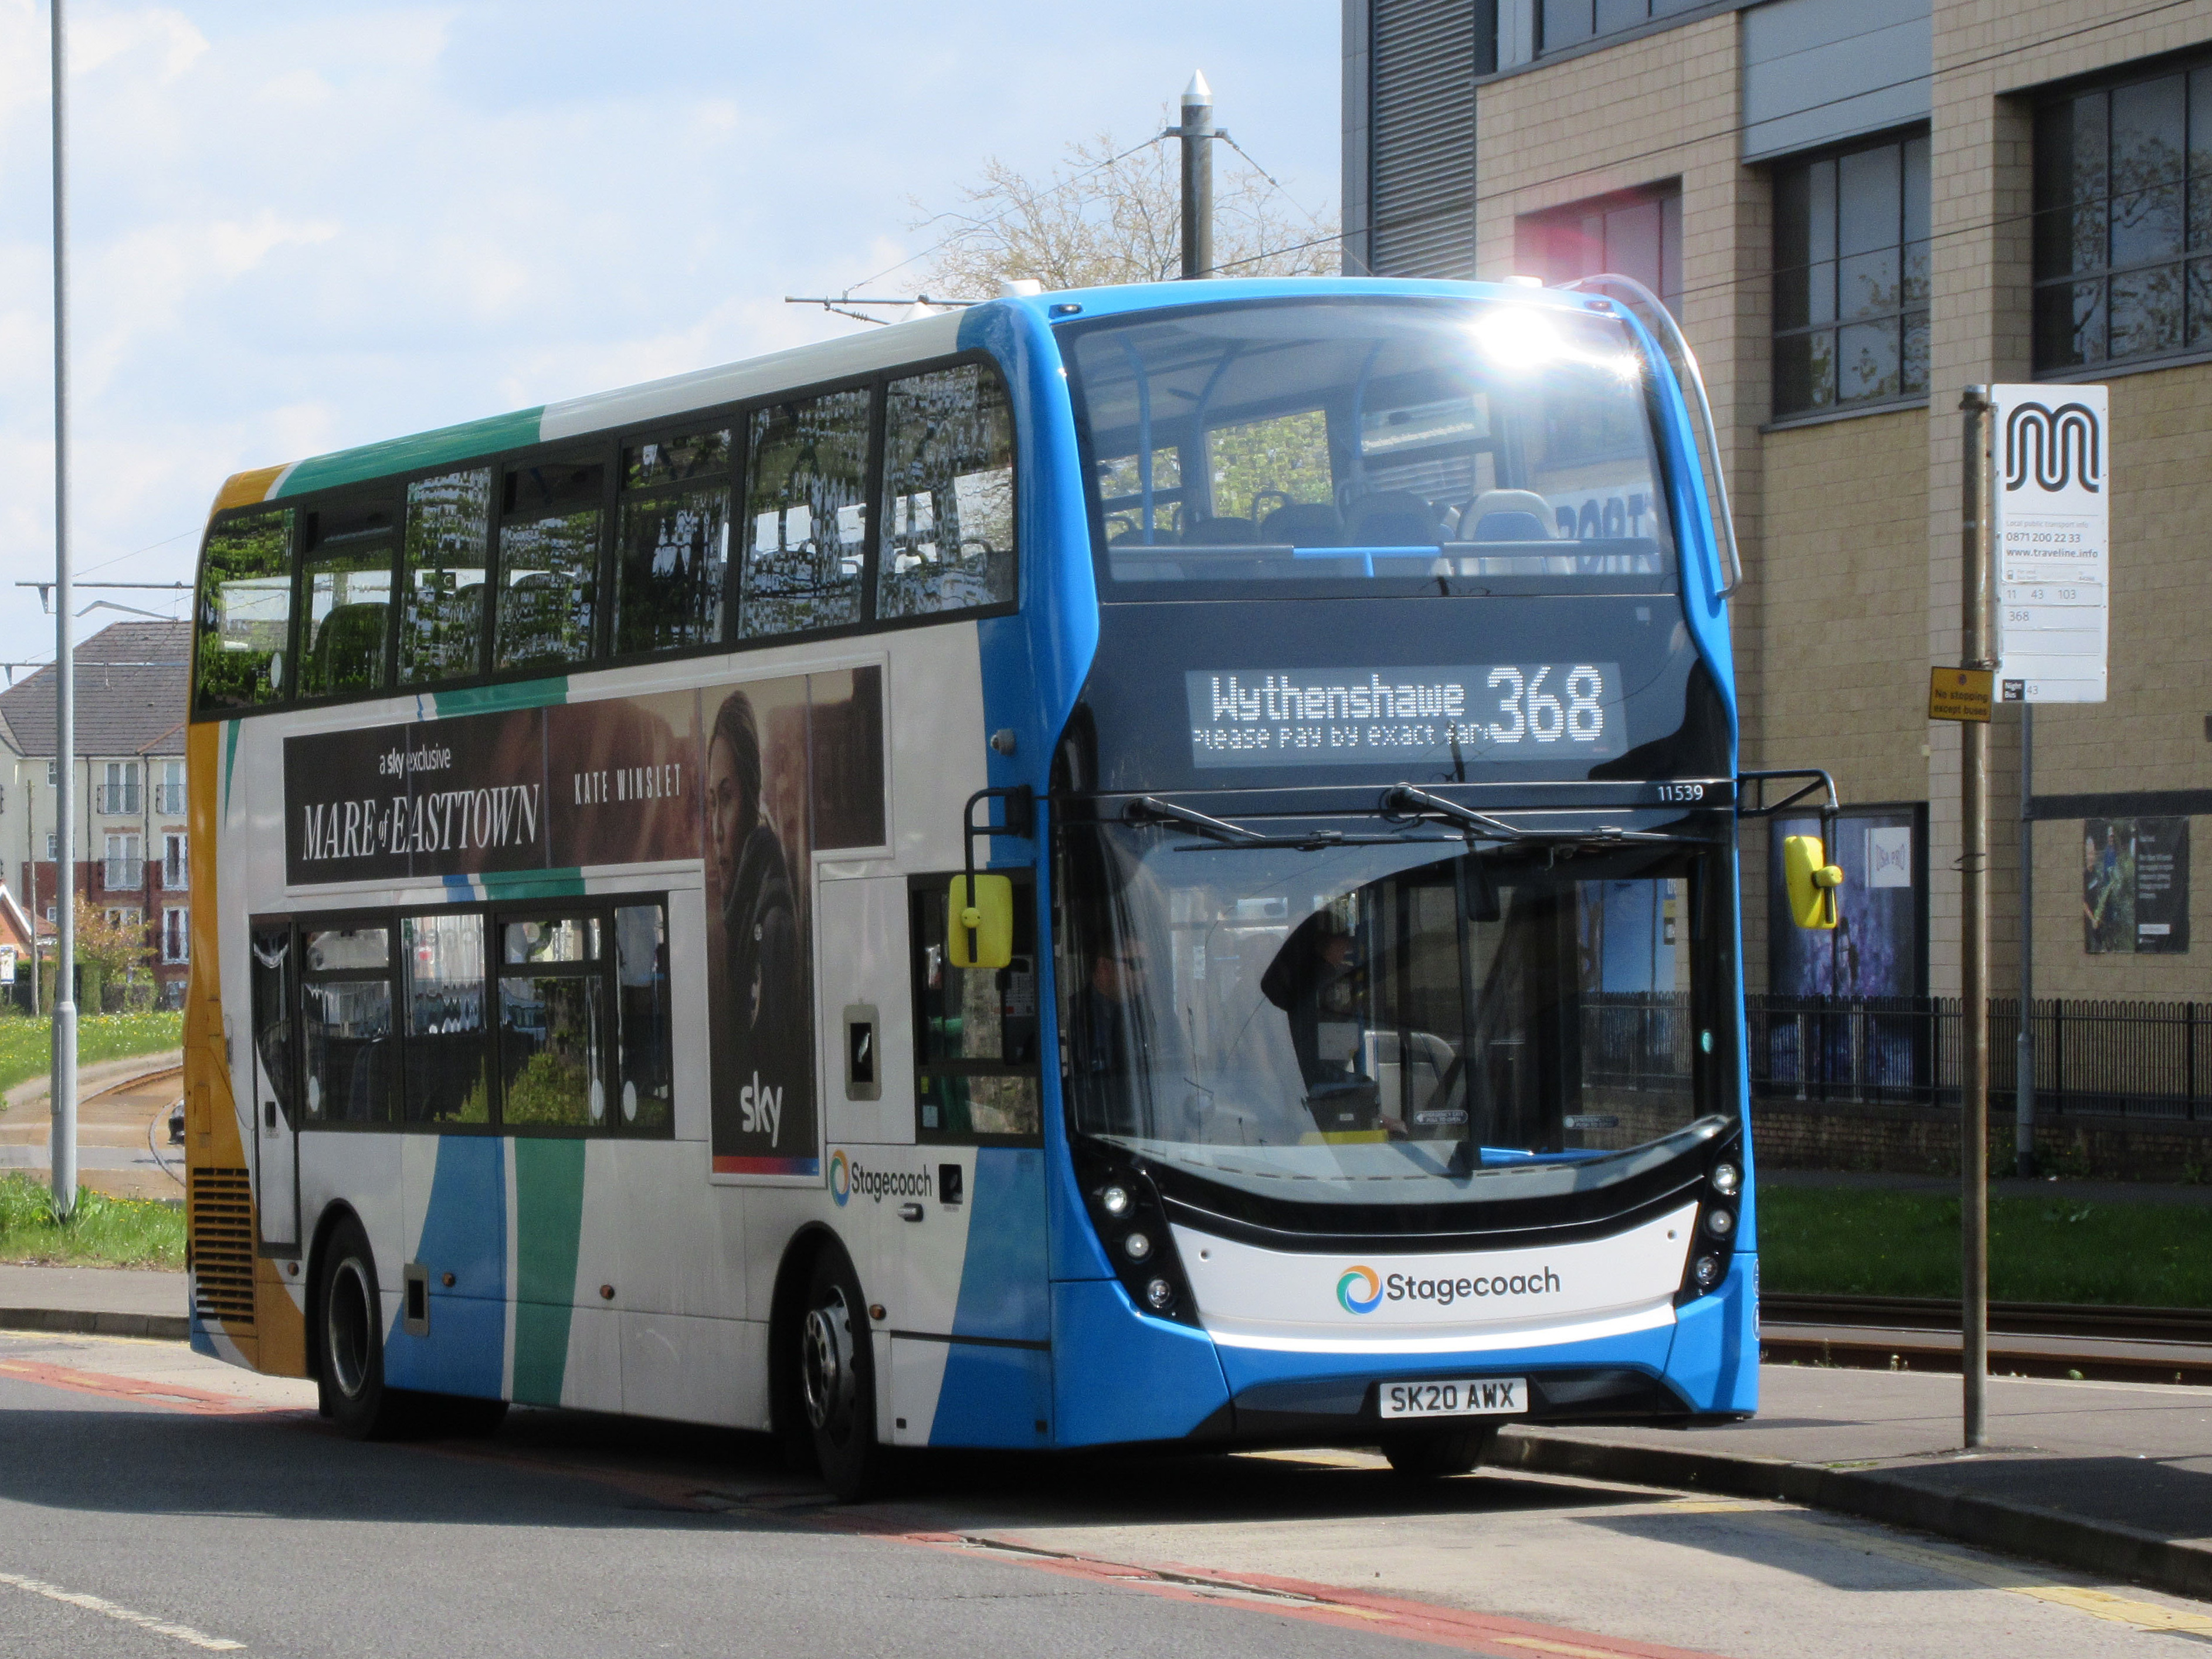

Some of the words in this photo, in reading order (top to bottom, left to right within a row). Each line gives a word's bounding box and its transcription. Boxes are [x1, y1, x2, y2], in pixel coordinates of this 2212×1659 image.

[2006, 532, 2030, 541] 0871
[2031, 533, 2052, 542] 200
[2054, 534, 2066, 542] 22
[2068, 534, 2081, 543] 33
[2006, 548, 2099, 558] www.traveline.info
[2007, 590, 2017, 599] 11
[2031, 589, 2044, 599] 43
[2058, 590, 2077, 599] 103
[2009, 611, 2029, 622] 368
[1211, 673, 1466, 722] Wythenshawe
[1487, 665, 1604, 743] 368
[1935, 690, 1947, 699] No
[1950, 691, 1990, 703] stopping
[2026, 686, 2039, 694] 43
[1933, 705, 1962, 715] except
[1963, 705, 1987, 715] buses
[380, 755, 386, 775] a
[387, 750, 405, 779] sky
[406, 745, 451, 771] exclusive
[574, 770, 608, 805] KATE
[617, 764, 681, 801] WINSLET
[1658, 785, 1704, 801] 11539
[302, 799, 376, 861] MARE
[391, 783, 540, 854] EASTTOWN
[740, 1071, 782, 1148] sky
[851, 1162, 932, 1203] Stagecoach
[1387, 1266, 1560, 1305] Stagecoach
[1391, 1385, 1457, 1412] SK20
[1467, 1383, 1515, 1409] AWX
